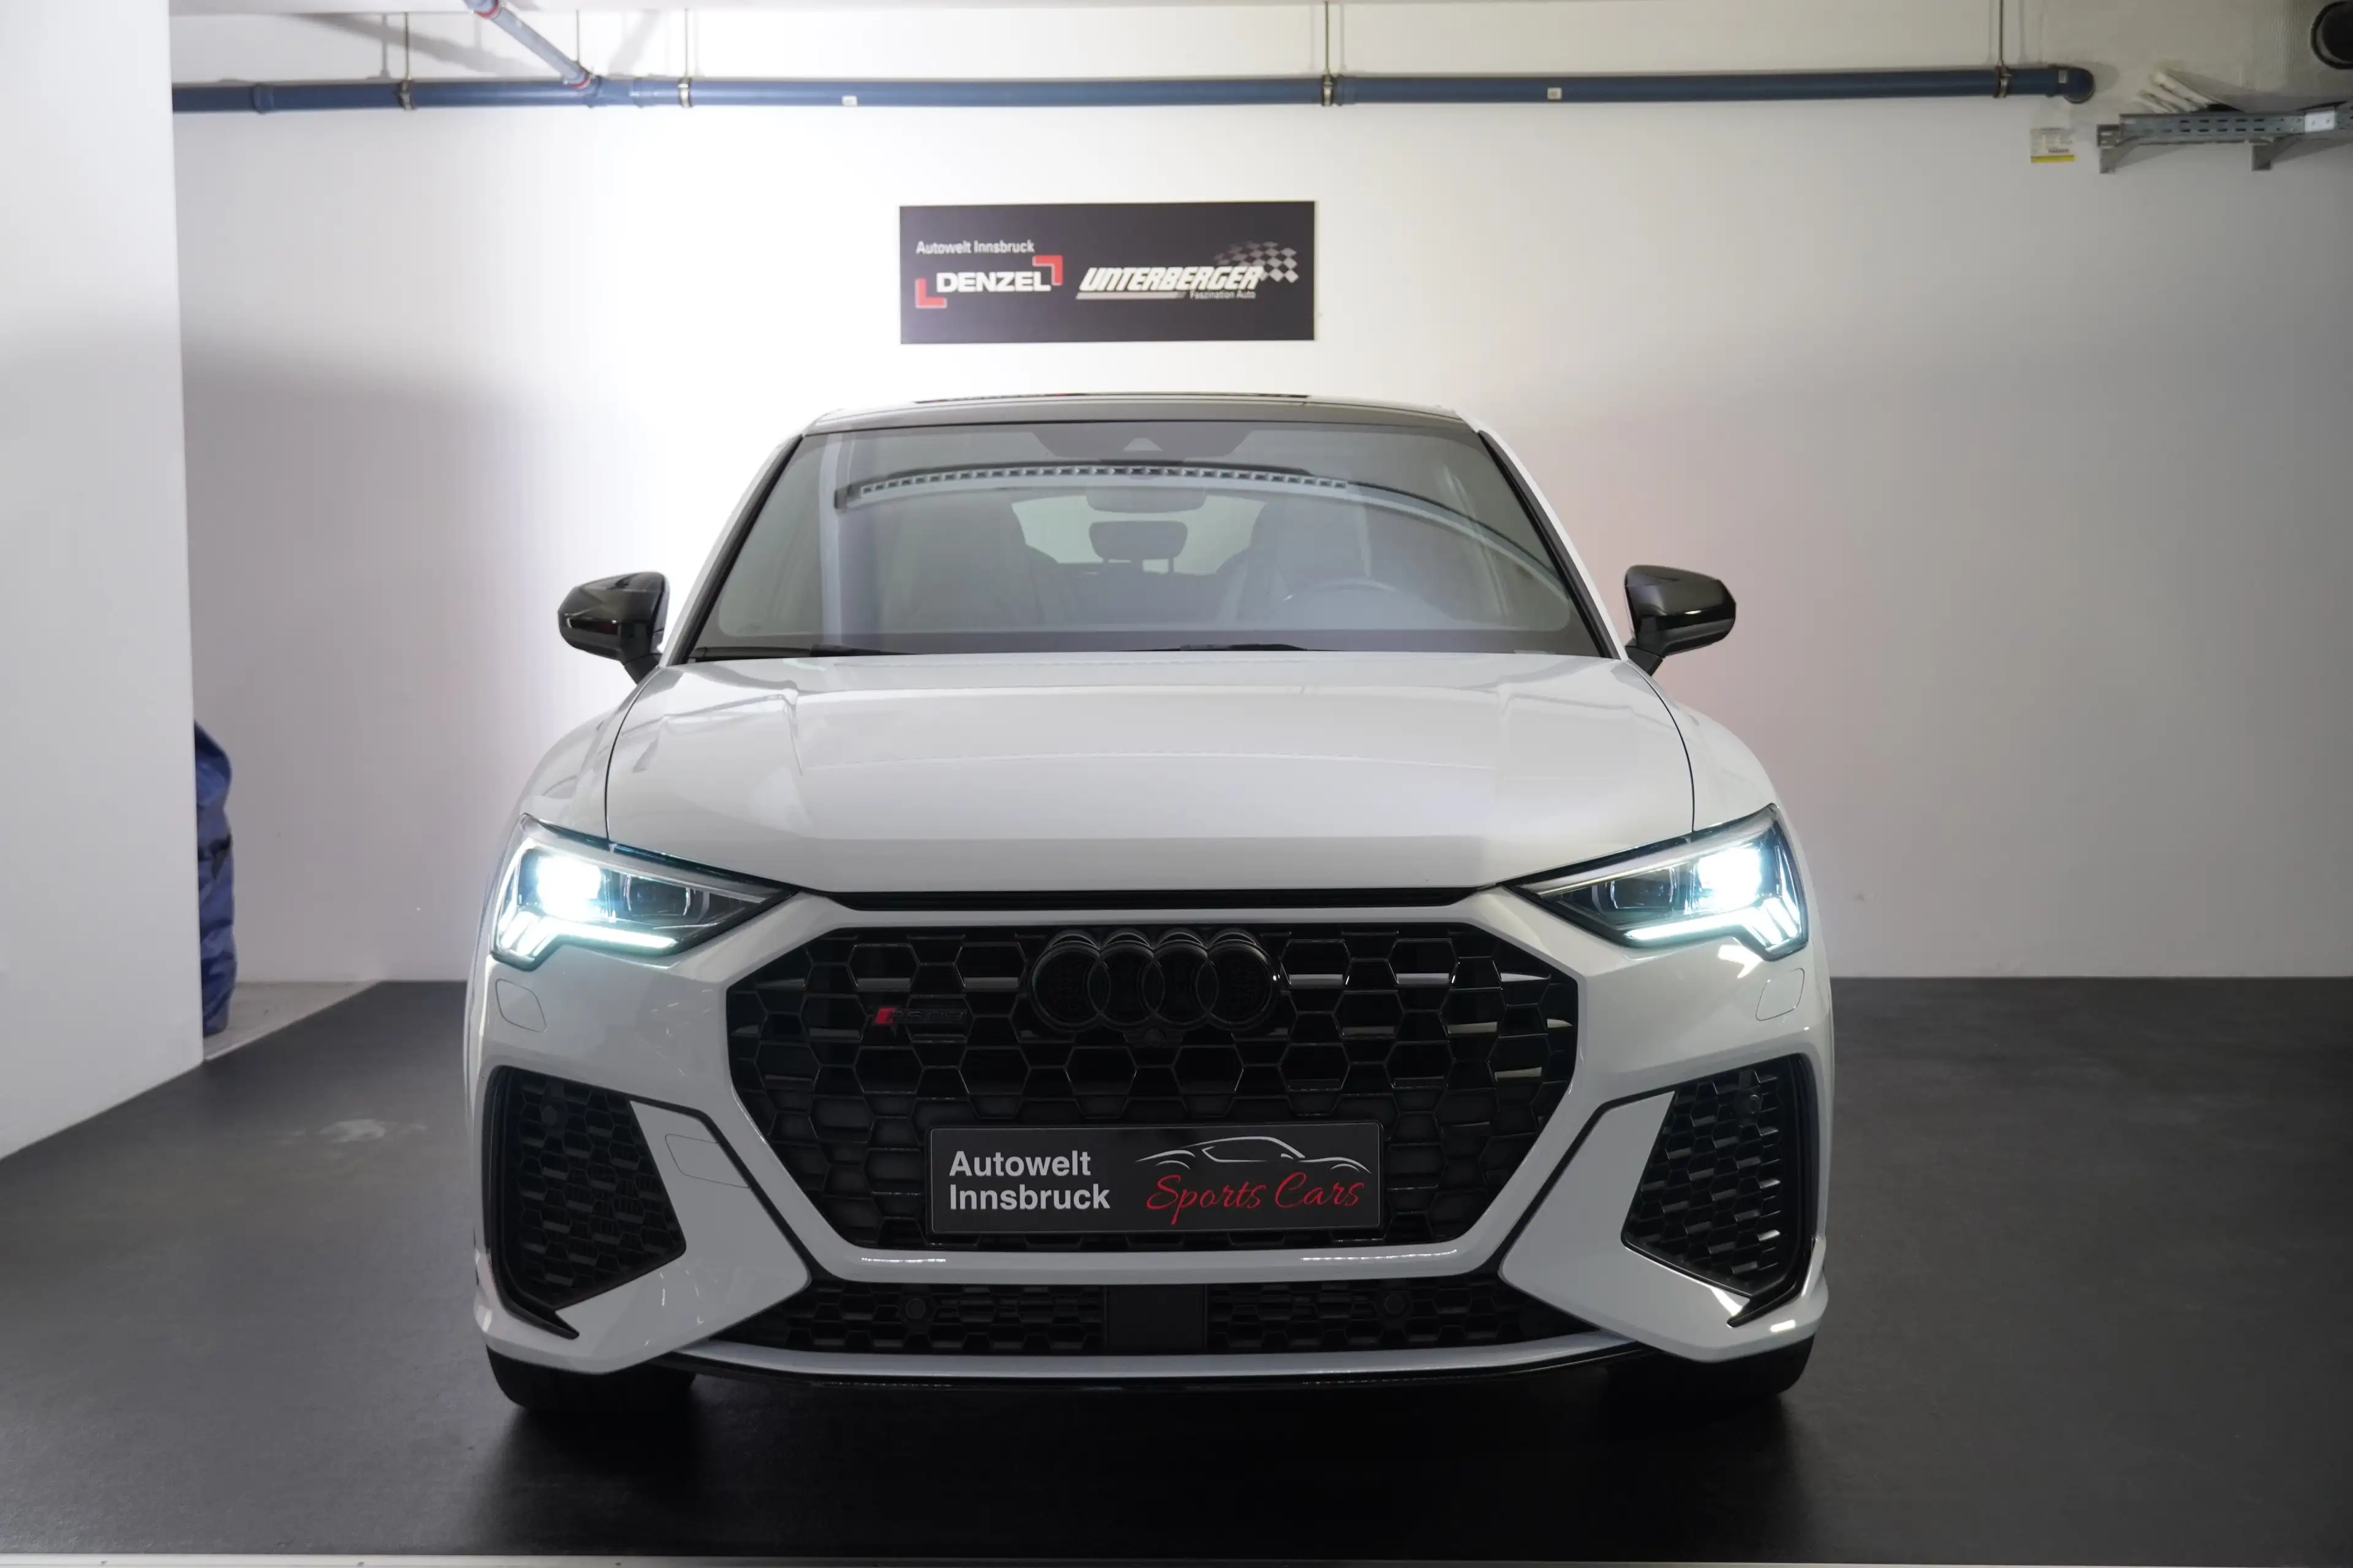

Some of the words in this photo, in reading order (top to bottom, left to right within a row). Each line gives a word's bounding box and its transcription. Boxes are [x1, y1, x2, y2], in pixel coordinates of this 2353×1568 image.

[915, 241, 972, 254] Autowelt
[974, 240, 1035, 253] Innsbruck
[936, 271, 1051, 292] DENZEL
[1079, 266, 1264, 291] UNTERBERGER
[1236, 289, 1256, 299] Auto
[949, 1150, 1091, 1177] Autowelt
[950, 1183, 1111, 1210] Innsbruck
[1146, 1174, 1267, 1225] Sports
[1274, 1172, 1365, 1209] Cars
